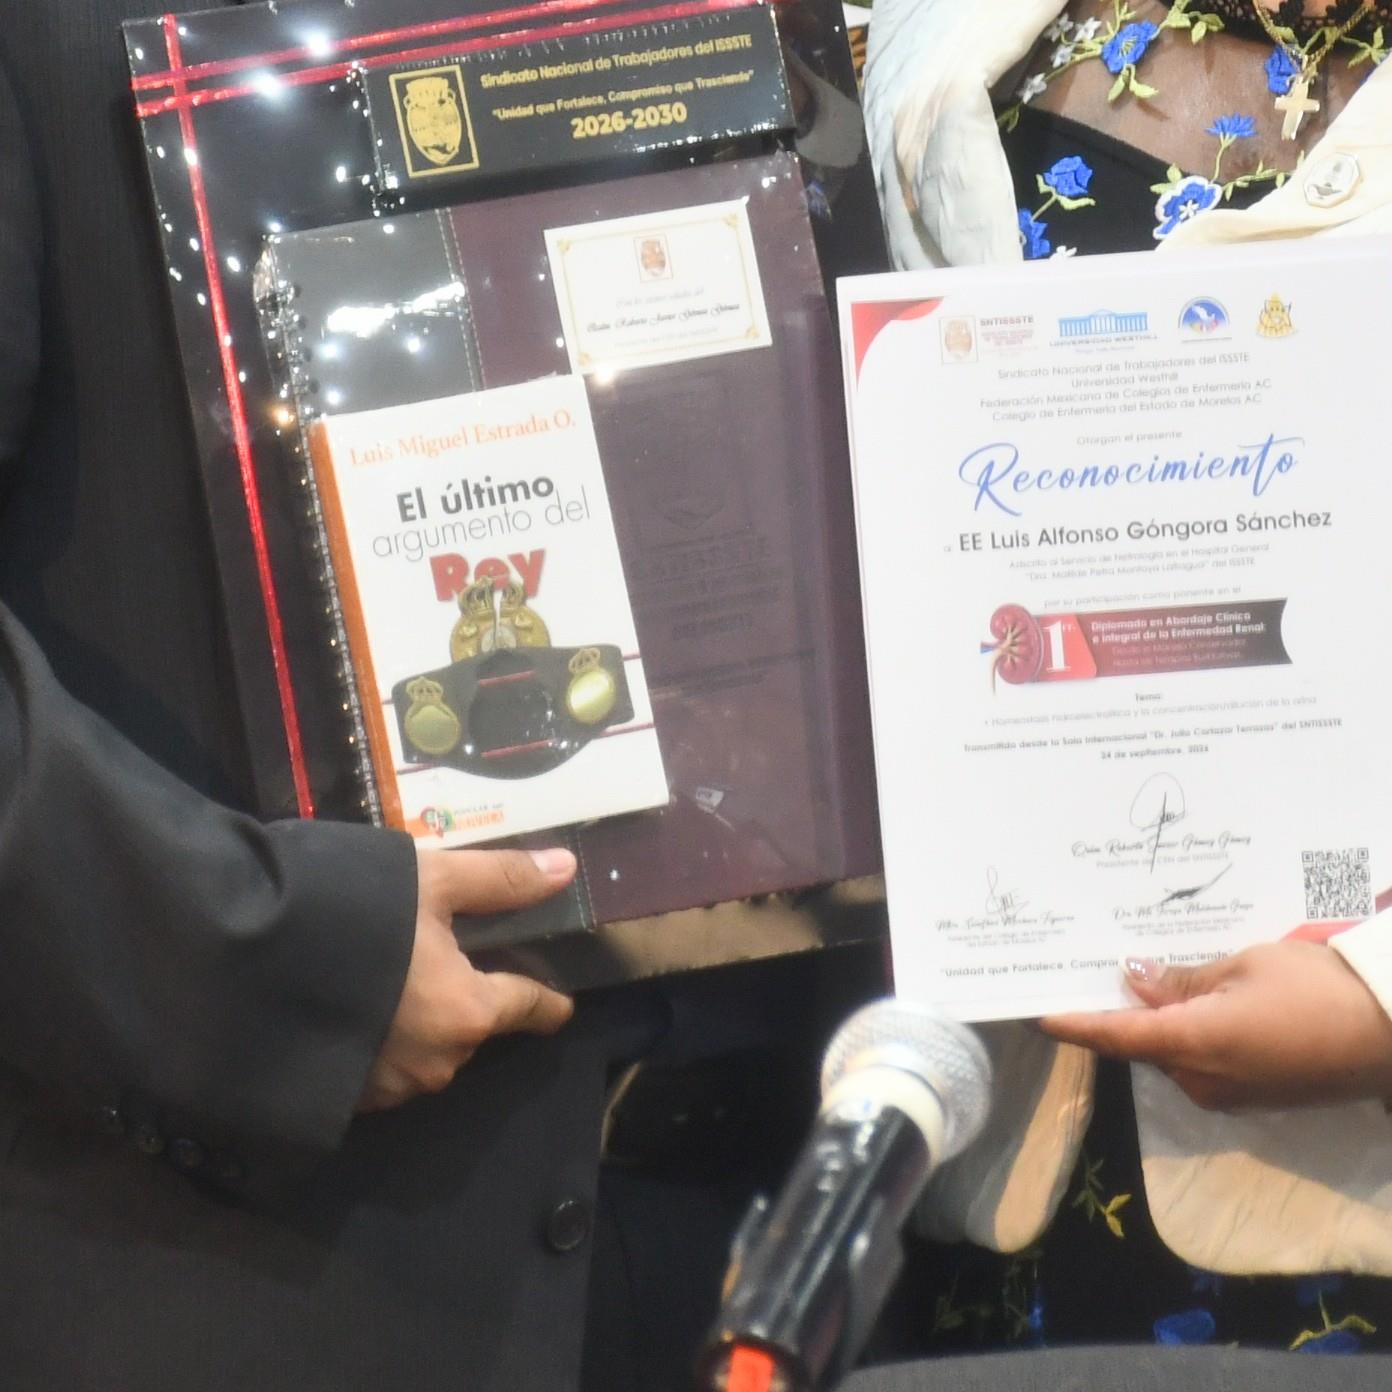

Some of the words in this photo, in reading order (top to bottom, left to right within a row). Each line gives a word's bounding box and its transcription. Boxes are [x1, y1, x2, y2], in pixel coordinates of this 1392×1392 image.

[480, 68, 538, 88] Sindicato
[539, 59, 594, 80] Nacional
[595, 57, 612, 70] de
[612, 44, 693, 66] Trabajadores
[695, 40, 714, 55] del
[716, 34, 752, 52] ISSSTE
[536, 103, 555, 116] que
[608, 84, 673, 102] Compromiso
[674, 81, 694, 95] que
[570, 101, 688, 139] 2026-2030
[998, 366, 1049, 380] Sindicato
[1052, 364, 1102, 377] Nacional
[1105, 362, 1120, 373] de
[1124, 357, 1196, 372] Trabajadores
[1198, 355, 1217, 366] del
[1219, 352, 1250, 364] ISSSTE
[1071, 374, 1135, 388] Universidad
[1138, 371, 1178, 384] Westhill
[980, 395, 1044, 409] Federación
[1047, 392, 1102, 406] Mexicana
[1105, 390, 1120, 401] de
[1123, 386, 1171, 401] Colegios
[1174, 384, 1189, 395] de
[1255, 378, 1272, 389] AC
[992, 409, 1036, 423] Colegio
[1039, 407, 1054, 418] de
[1119, 401, 1137, 412] del
[1140, 399, 1177, 412] Estado
[1180, 398, 1195, 409] de
[1199, 394, 1242, 408] Morelos
[1244, 393, 1262, 404] AC
[348, 438, 394, 468] Luis
[398, 426, 469, 462] Miguel
[473, 414, 550, 444] Estrada
[554, 408, 578, 430] O.
[1136, 431, 1183, 443] presente
[958, 432, 1306, 517] Reconocimiento
[395, 489, 428, 524] El
[439, 473, 555, 516] último
[372, 505, 533, 563] argumento
[544, 484, 592, 525] del
[959, 532, 983, 552] EE
[990, 527, 1030, 550] Luis
[1037, 522, 1119, 547] Alfonso
[1126, 517, 1229, 543] Góngora
[1236, 509, 1333, 532] Sánchez
[429, 548, 546, 603] Rey
[1091, 618, 1147, 632] Diplomado
[1150, 617, 1164, 628] en
[1166, 612, 1213, 628] Abordaje
[1215, 610, 1251, 624] Clínica
[1143, 628, 1157, 640] de
[1171, 622, 1233, 638] Enfermedad
